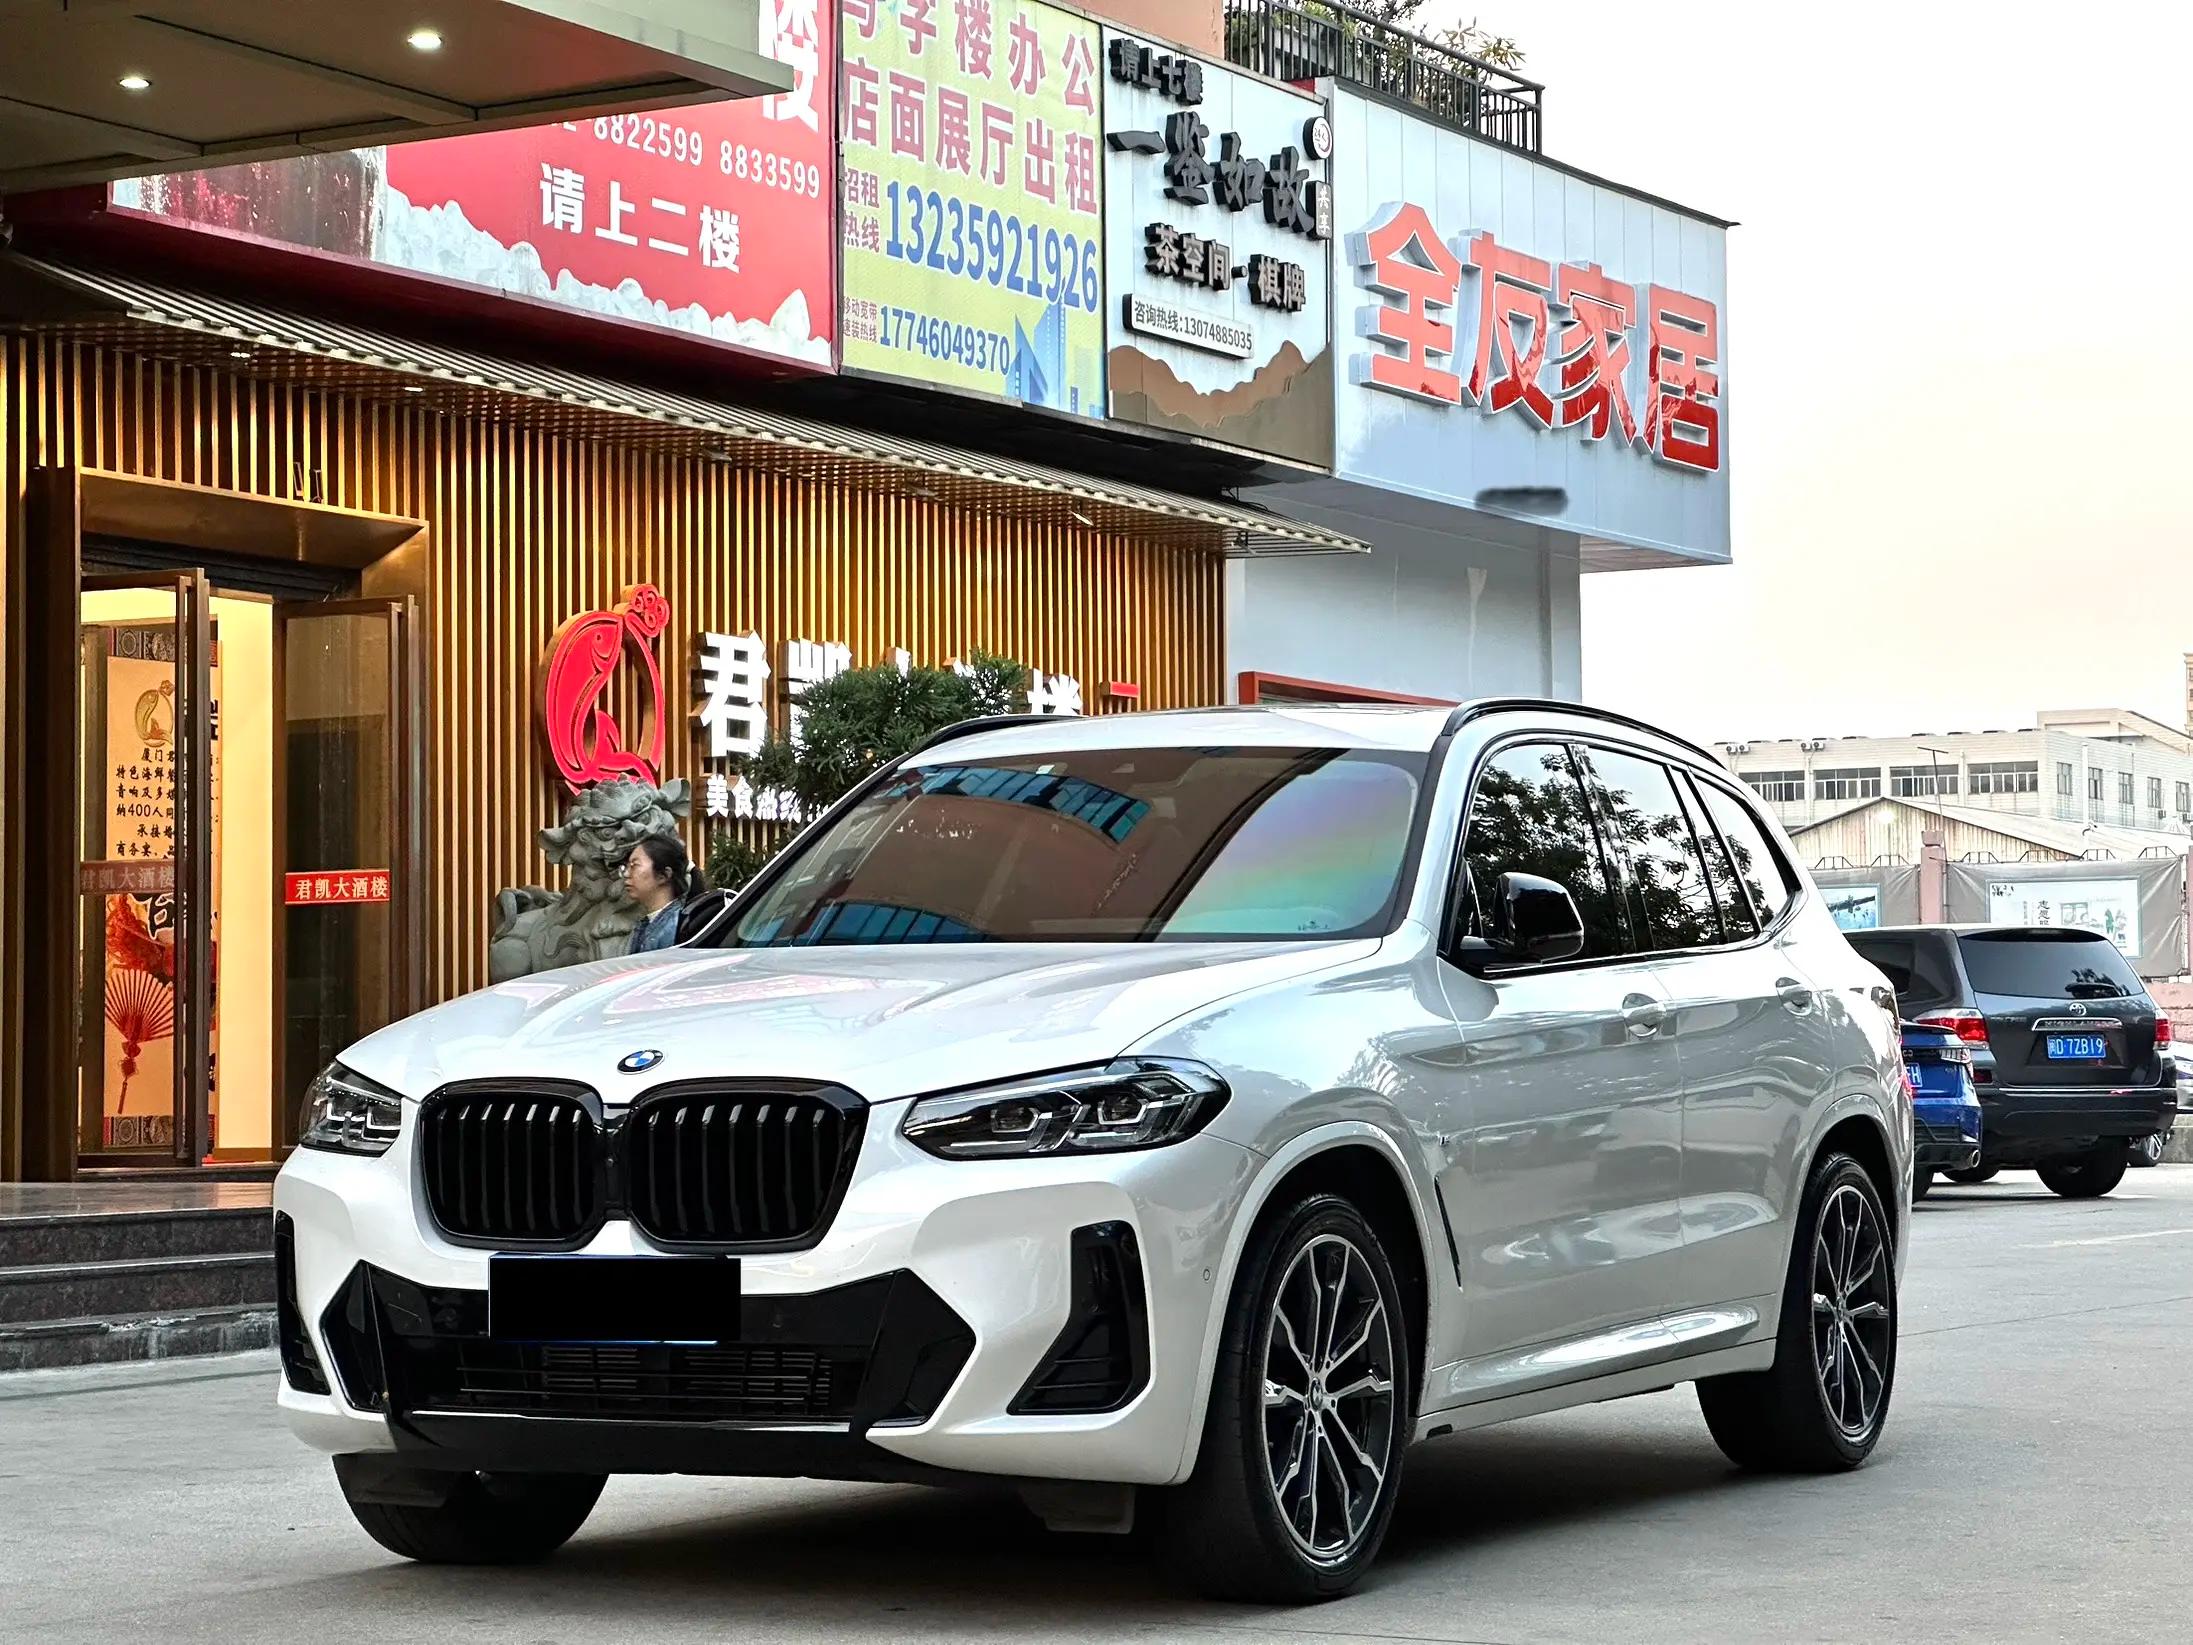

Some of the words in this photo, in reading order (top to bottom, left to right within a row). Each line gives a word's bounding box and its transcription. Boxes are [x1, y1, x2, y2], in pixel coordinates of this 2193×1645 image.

[719, 140, 820, 199] 8833599
[843, 57, 1098, 215] 店面展厅出租
[539, 161, 740, 274] 请上二楼
[886, 180, 1098, 313] 13235921926
[880, 305, 1011, 377] 17746049370
[1346, 201, 1720, 473] 全友家居
[296, 875, 388, 900] 君凯大酒楼
